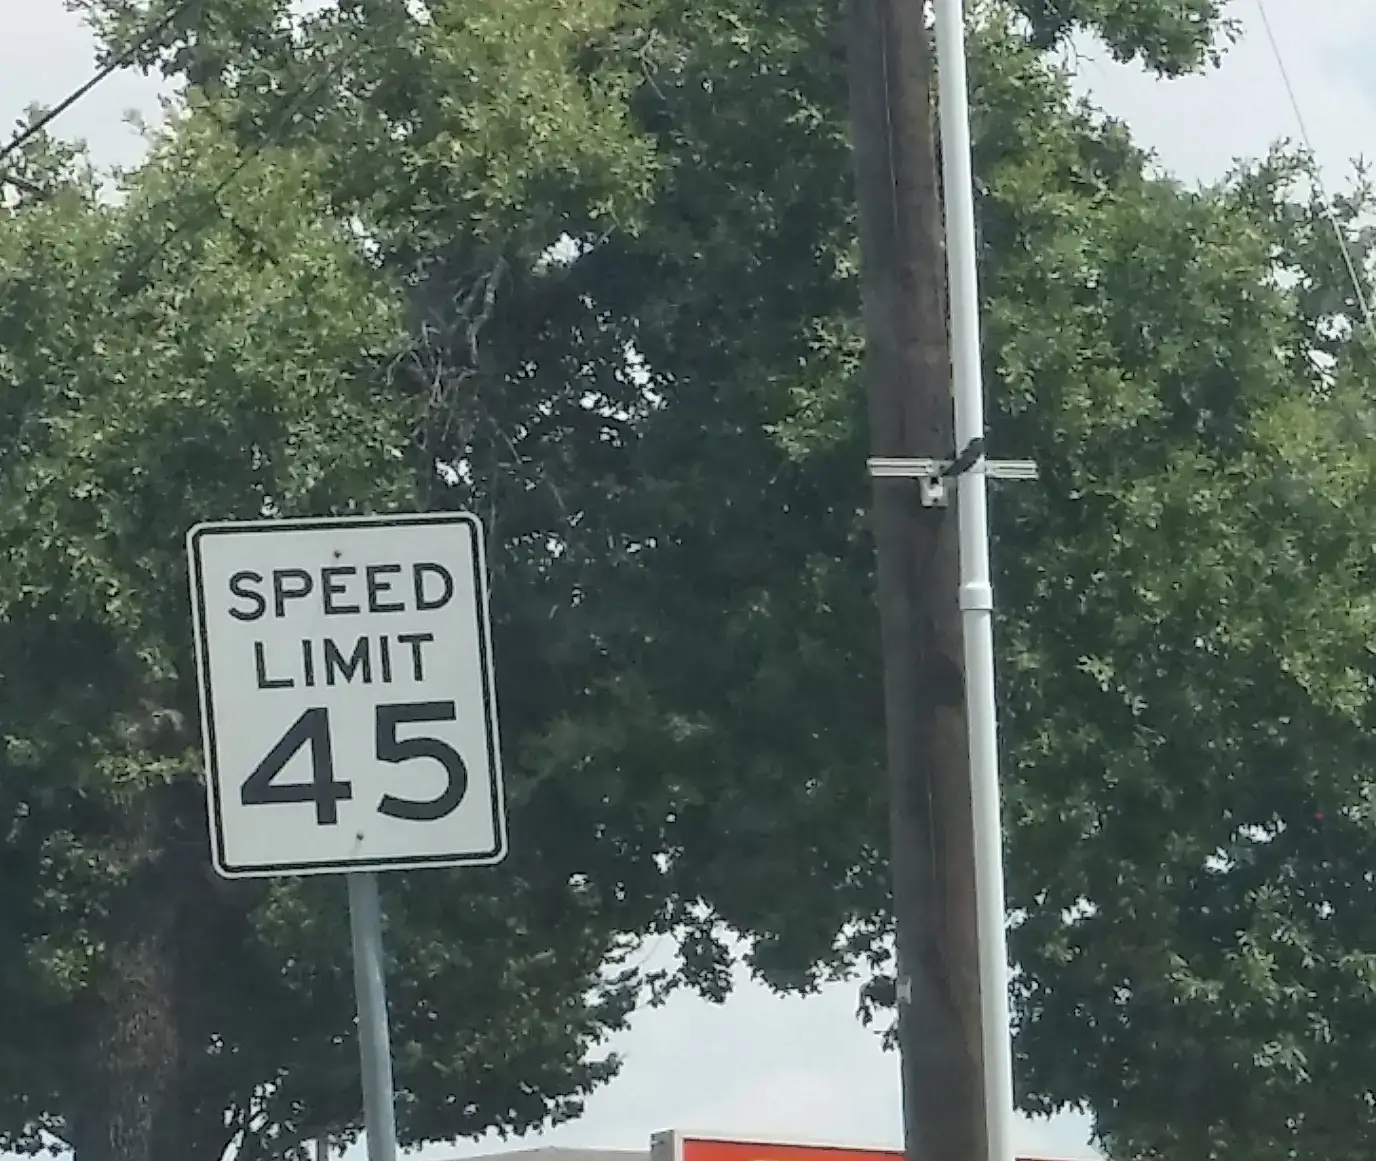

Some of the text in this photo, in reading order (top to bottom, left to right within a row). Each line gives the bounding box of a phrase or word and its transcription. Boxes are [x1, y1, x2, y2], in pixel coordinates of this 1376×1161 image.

[228, 562, 454, 621] SPEED
[254, 632, 434, 689] LIMIT
[240, 700, 469, 826] 45
